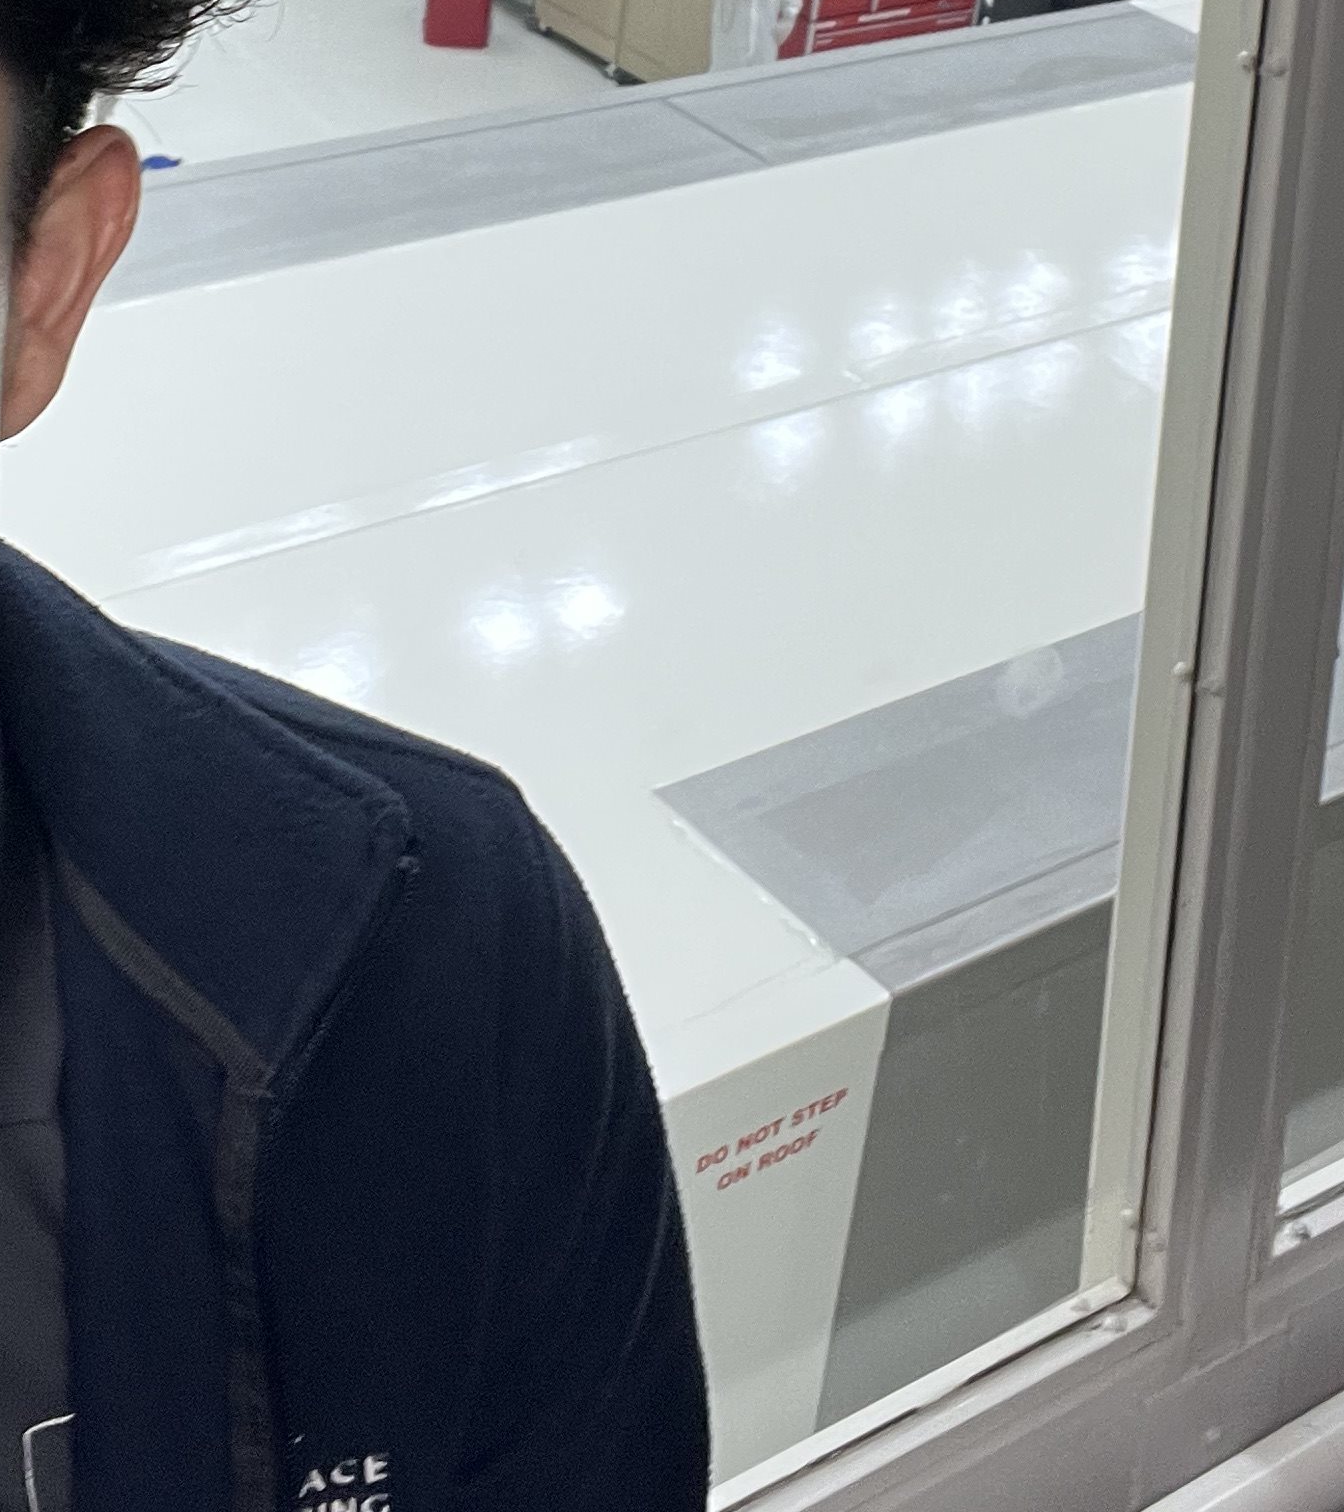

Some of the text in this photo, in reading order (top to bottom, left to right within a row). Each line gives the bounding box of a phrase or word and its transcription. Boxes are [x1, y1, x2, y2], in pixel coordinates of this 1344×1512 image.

[695, 1086, 849, 1175] DO NOT STEP
[716, 1126, 824, 1191] ON ROOF
